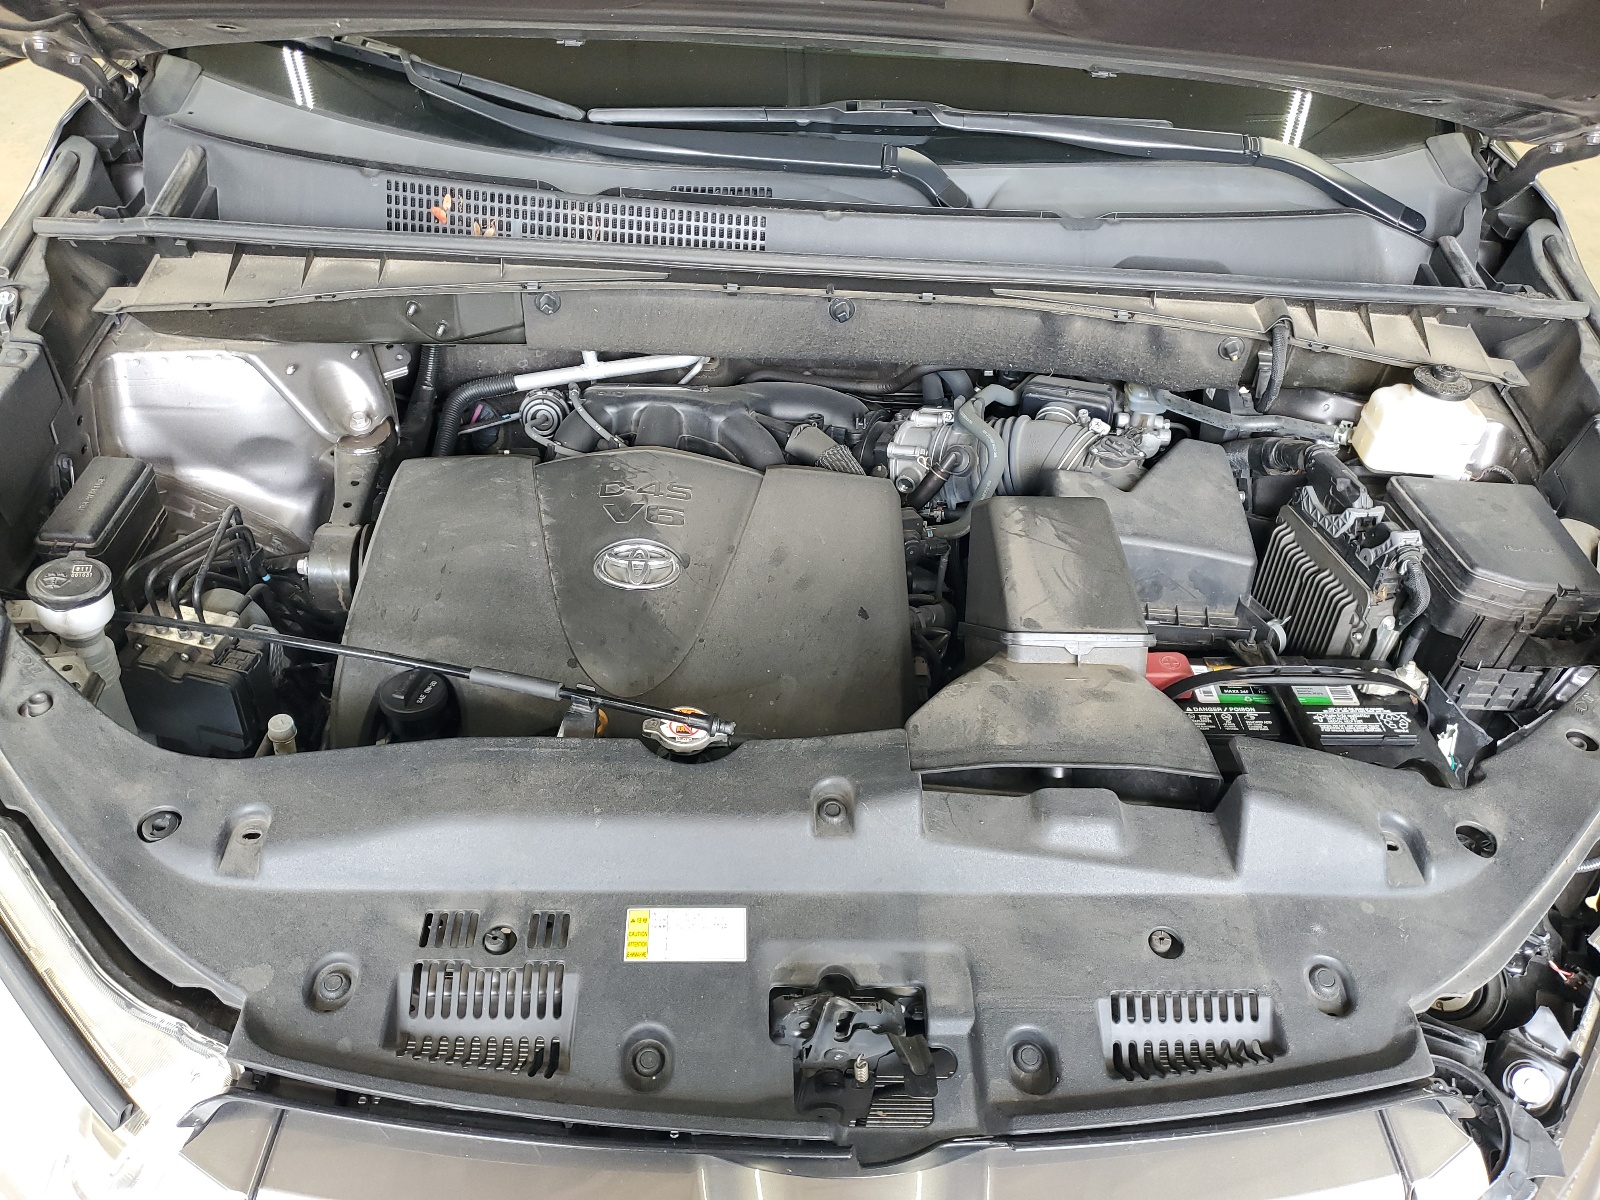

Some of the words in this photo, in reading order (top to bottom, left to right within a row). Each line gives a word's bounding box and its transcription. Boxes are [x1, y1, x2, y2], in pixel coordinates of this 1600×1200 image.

[599, 480, 692, 501] D-4S
[603, 503, 686, 527] V6
[416, 694, 427, 704] SAE
